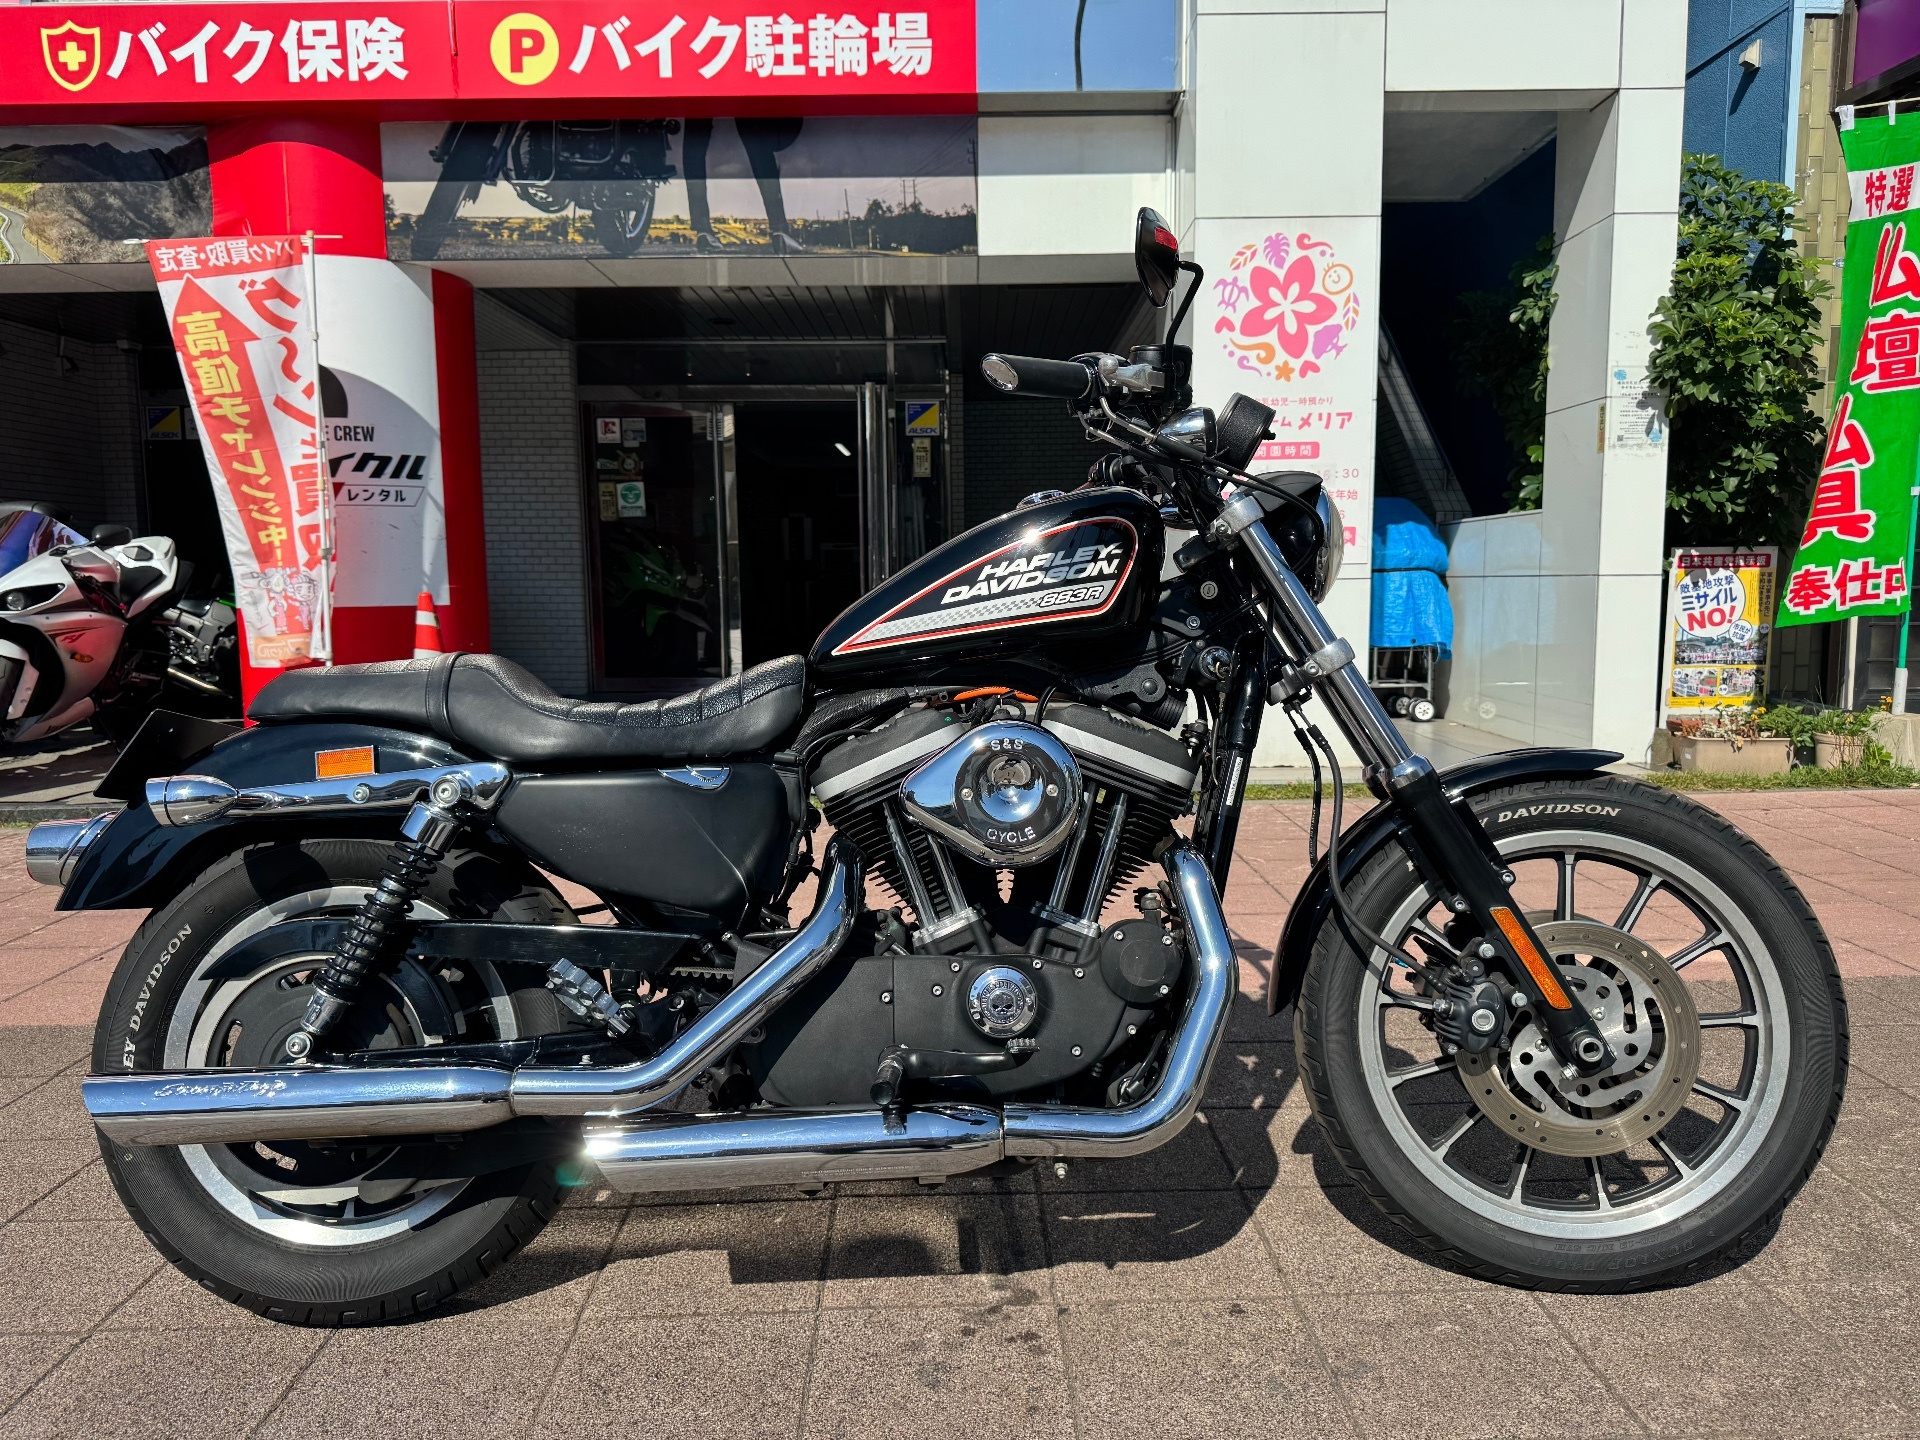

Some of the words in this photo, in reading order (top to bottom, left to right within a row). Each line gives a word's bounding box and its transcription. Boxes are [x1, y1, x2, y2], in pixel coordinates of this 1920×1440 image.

[107, 17, 409, 83] バイク保険
[508, 28, 545, 73] P
[568, 12, 932, 79] バイク駐輪場
[1864, 164, 1915, 218] 特選
[1255, 396, 1334, 407] 乳幼児一時預かり
[333, 425, 375, 442] CREW
[1318, 468, 1360, 481] 6:30
[347, 489, 407, 502] レンタル
[1681, 555, 1767, 566] 日本共産党掲示板
[940, 558, 1120, 605] DAVIDSON
[1680, 574, 1735, 595] 敵基地攻撃
[1039, 585, 1104, 608] 883R
[1681, 587, 1738, 612] ミサイル
[1687, 605, 1737, 631] NO!
[991, 738, 1024, 750] S&S
[1498, 804, 1622, 823] DAVIDSON
[987, 826, 1036, 843] CYCLE
